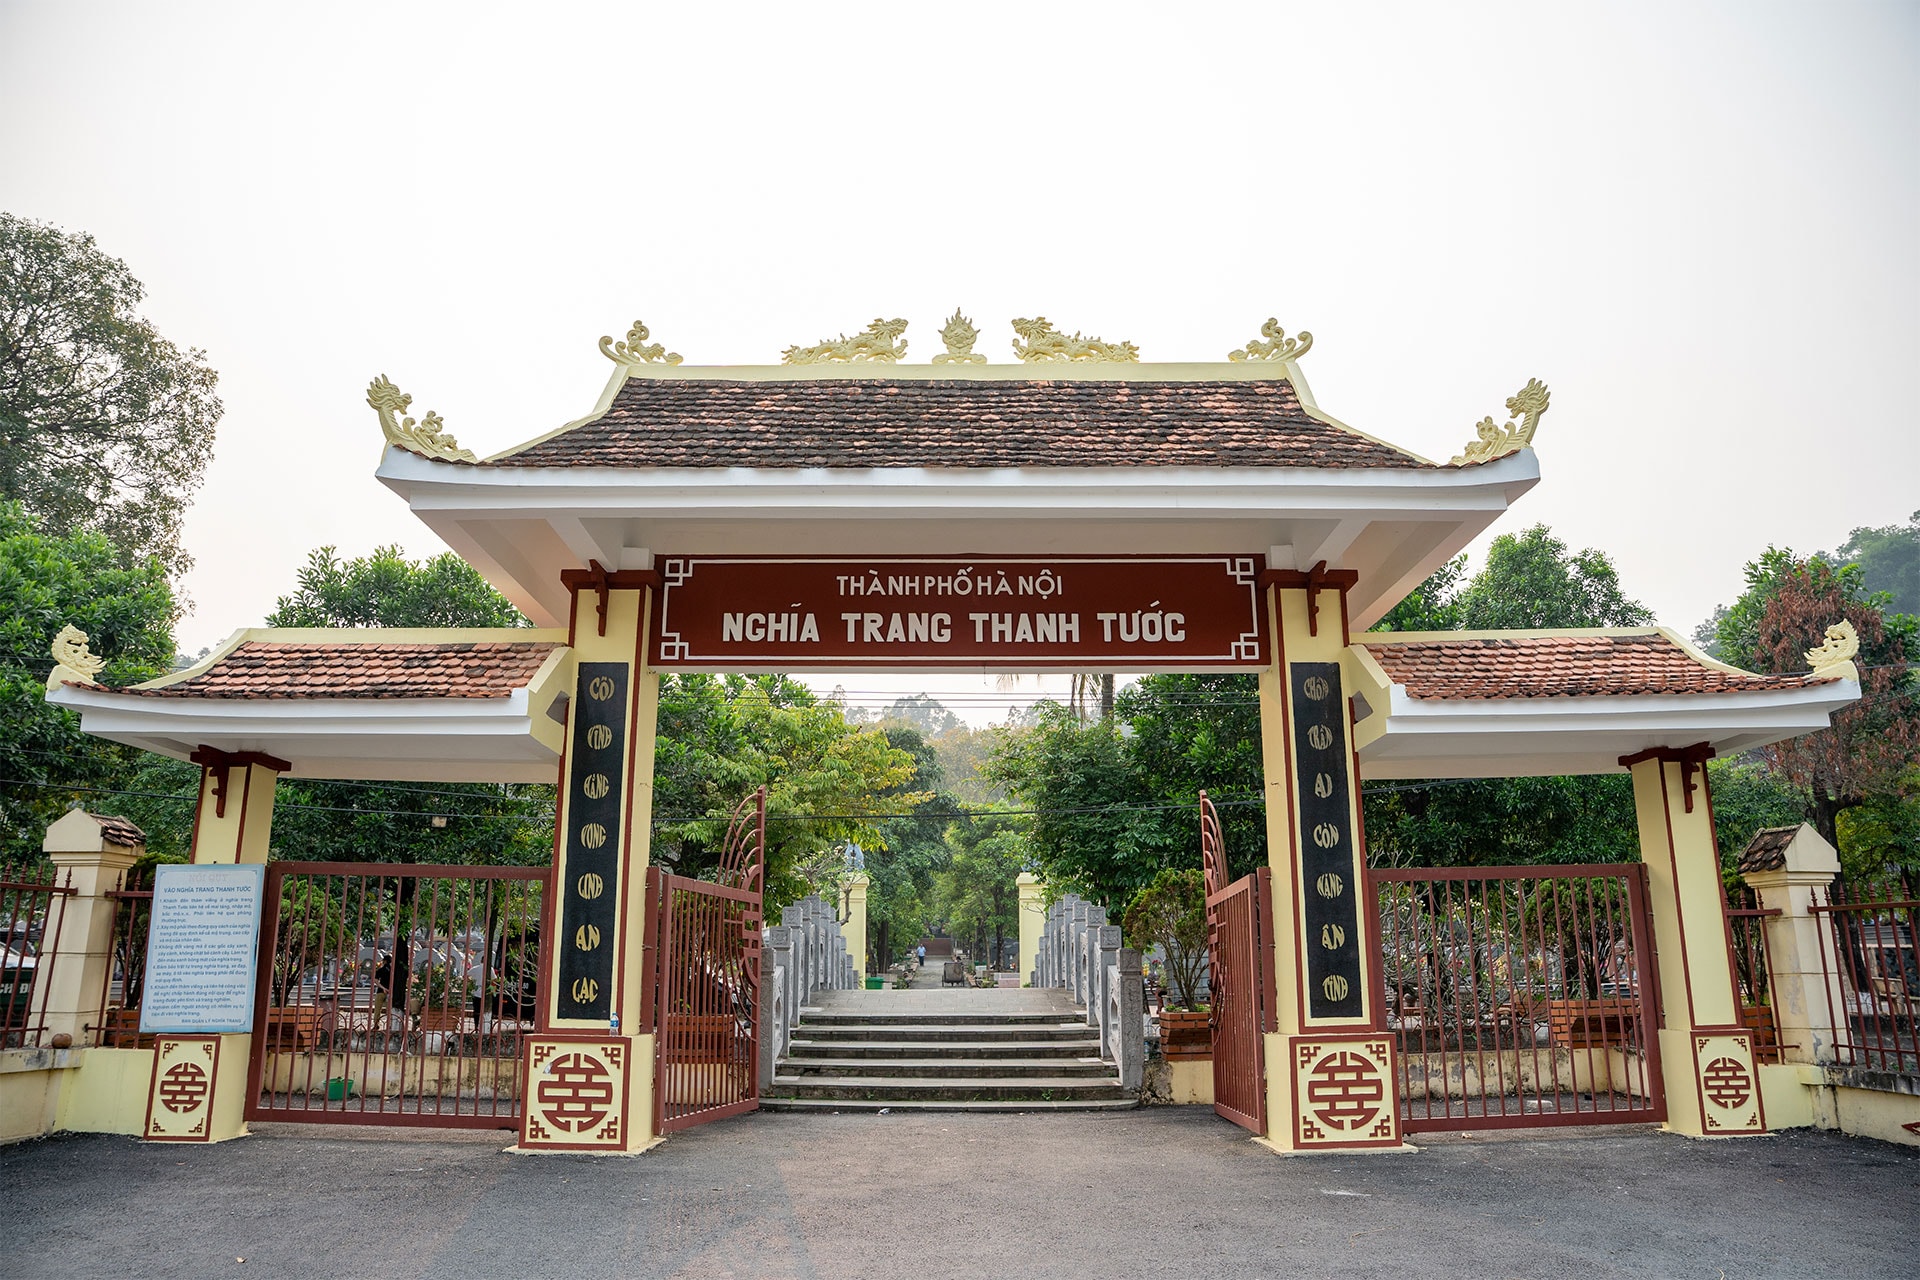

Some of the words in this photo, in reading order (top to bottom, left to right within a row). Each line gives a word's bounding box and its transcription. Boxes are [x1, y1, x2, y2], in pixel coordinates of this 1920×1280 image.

[837, 570, 920, 596] THÀNH
[925, 567, 973, 596] PHỐ
[978, 570, 1014, 596] HÀ
[1019, 570, 1062, 599] NỘI
[723, 602, 820, 642] NGHĨA
[842, 613, 952, 642] TRANG
[969, 613, 1080, 642] THANH
[1097, 601, 1186, 642] TƯỚC
[580, 823, 606, 849] VONG
[1313, 822, 1339, 850] CÒN
[578, 872, 604, 900] LINH
[575, 924, 601, 952] AN
[1322, 923, 1346, 951] ÂN
[572, 977, 599, 1004] LẠC
